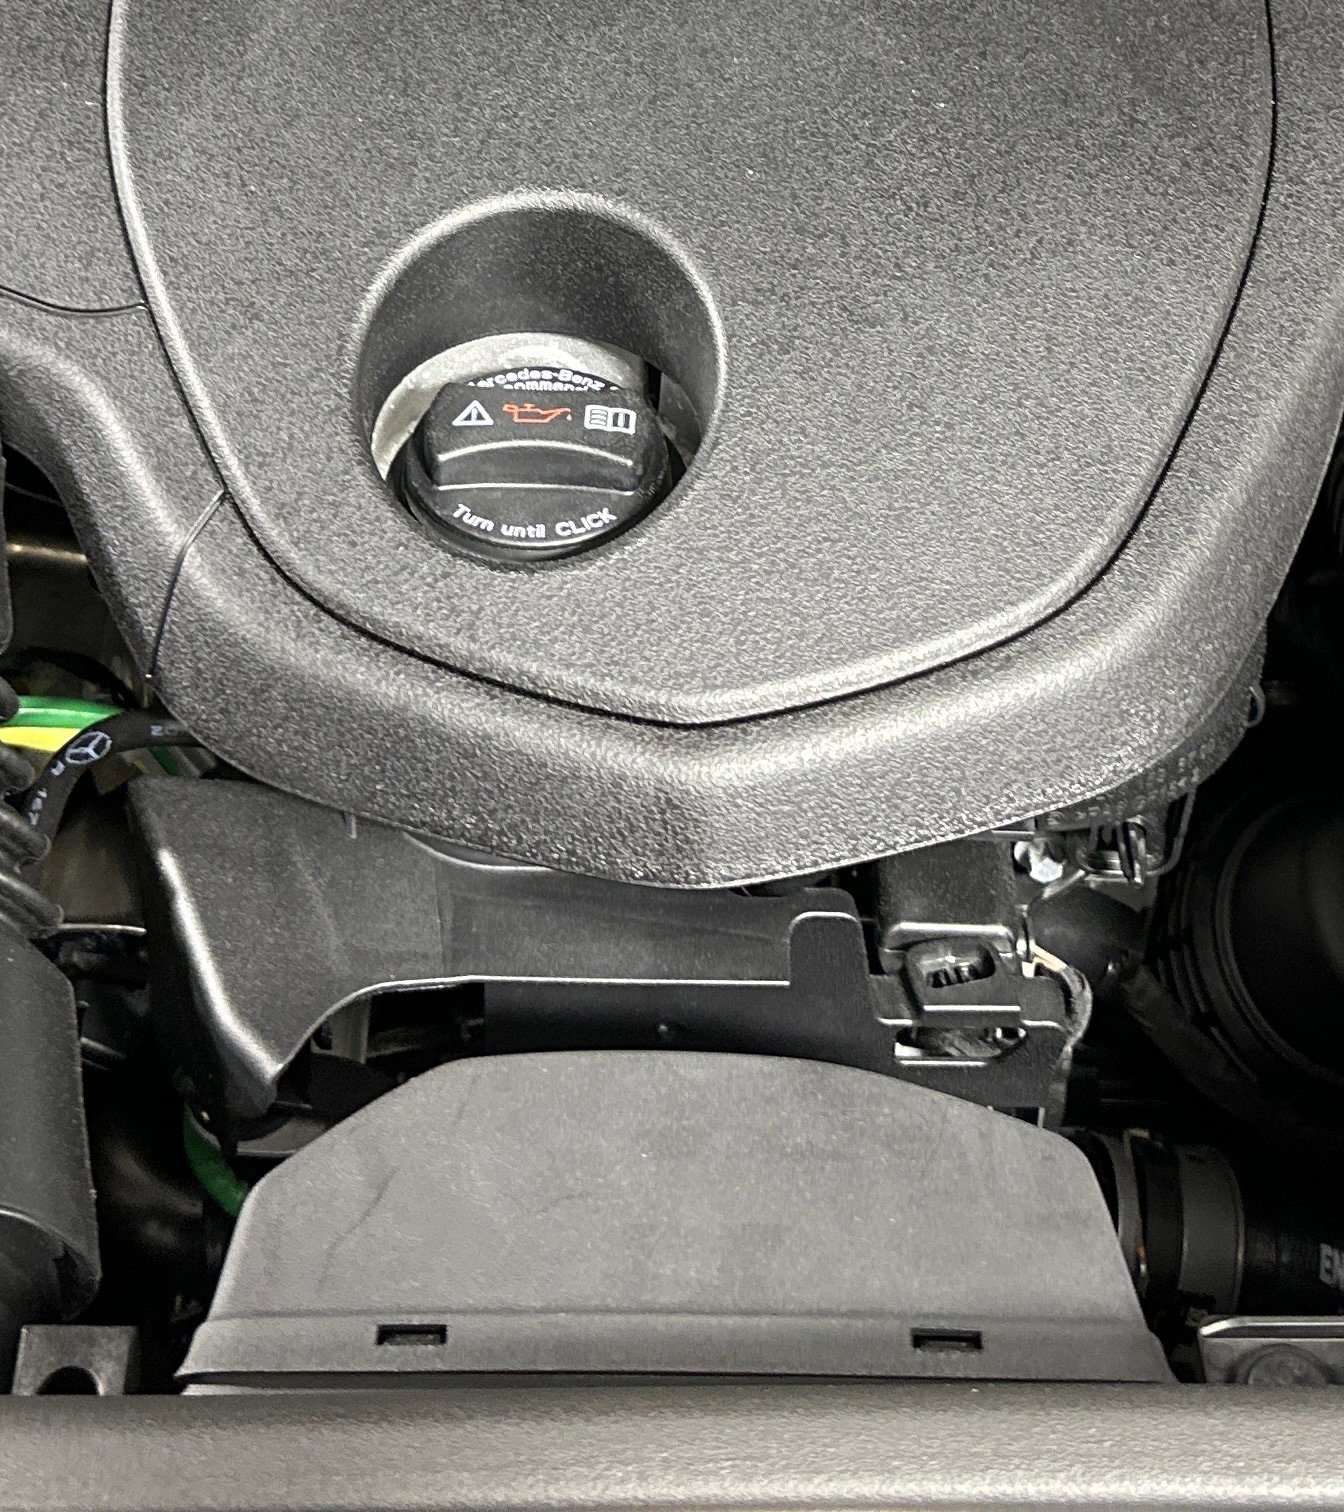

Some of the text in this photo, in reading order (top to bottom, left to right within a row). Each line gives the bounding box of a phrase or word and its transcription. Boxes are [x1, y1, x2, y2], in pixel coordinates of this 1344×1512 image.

[453, 503, 617, 538] Turn until CLICK
